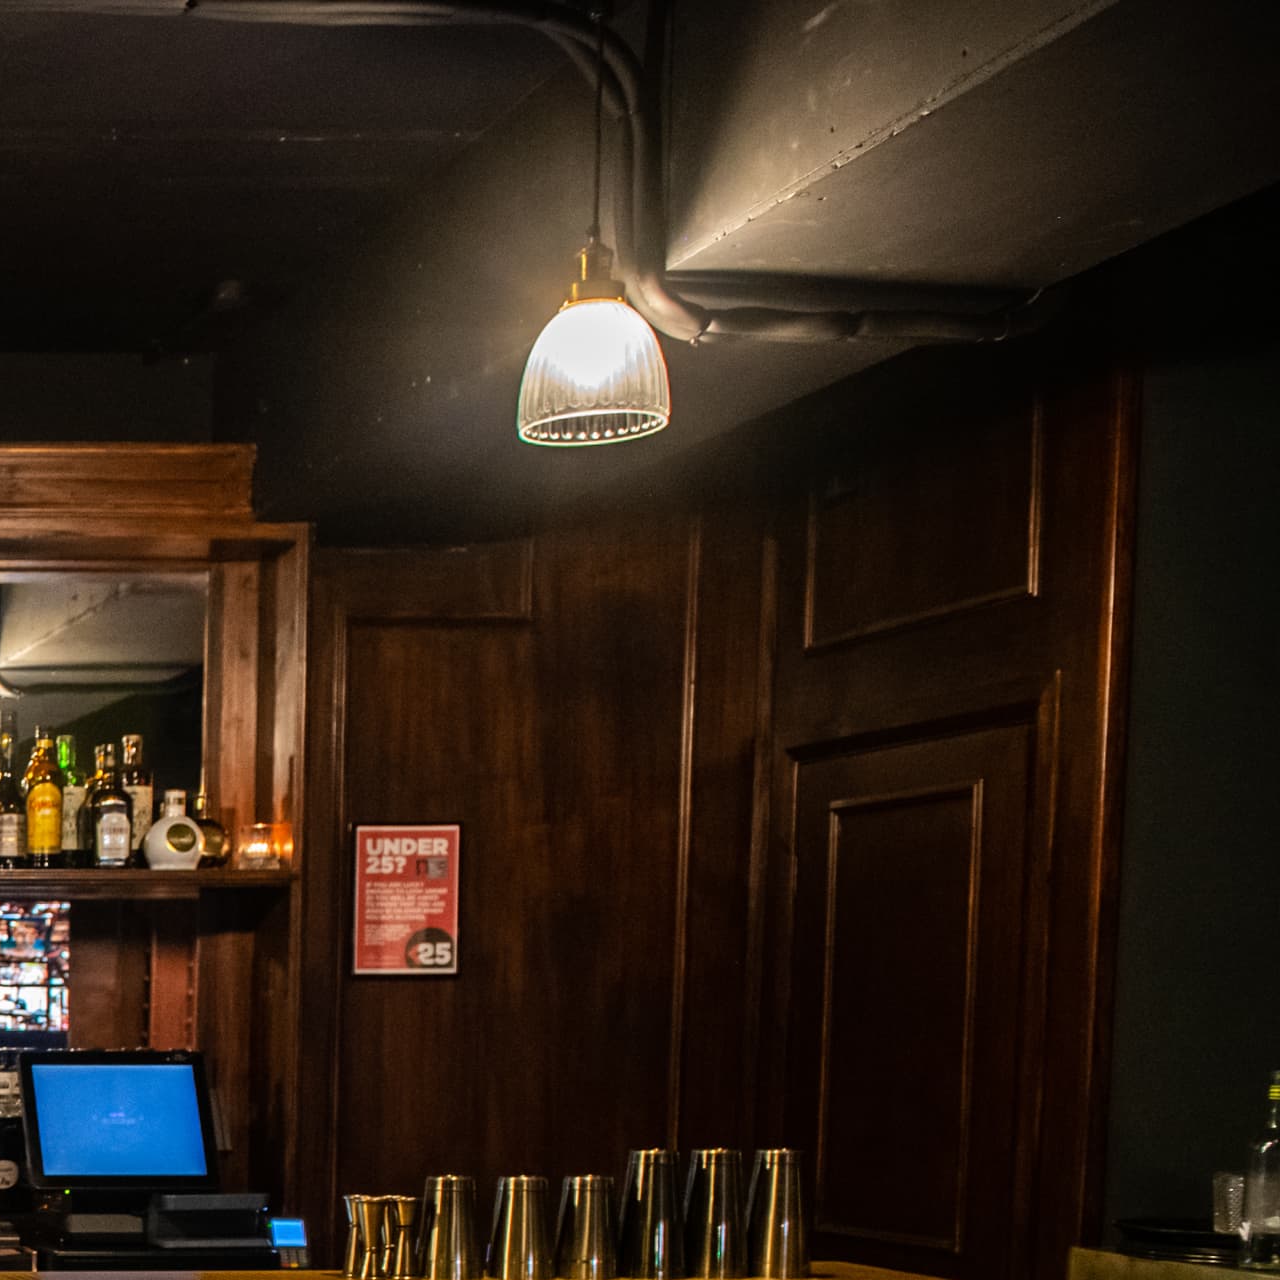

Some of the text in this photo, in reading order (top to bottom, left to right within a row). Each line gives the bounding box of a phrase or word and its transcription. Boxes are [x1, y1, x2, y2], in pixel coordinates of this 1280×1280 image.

[366, 838, 448, 855] UNDER
[366, 856, 407, 874] 25?
[417, 942, 451, 965] 25
